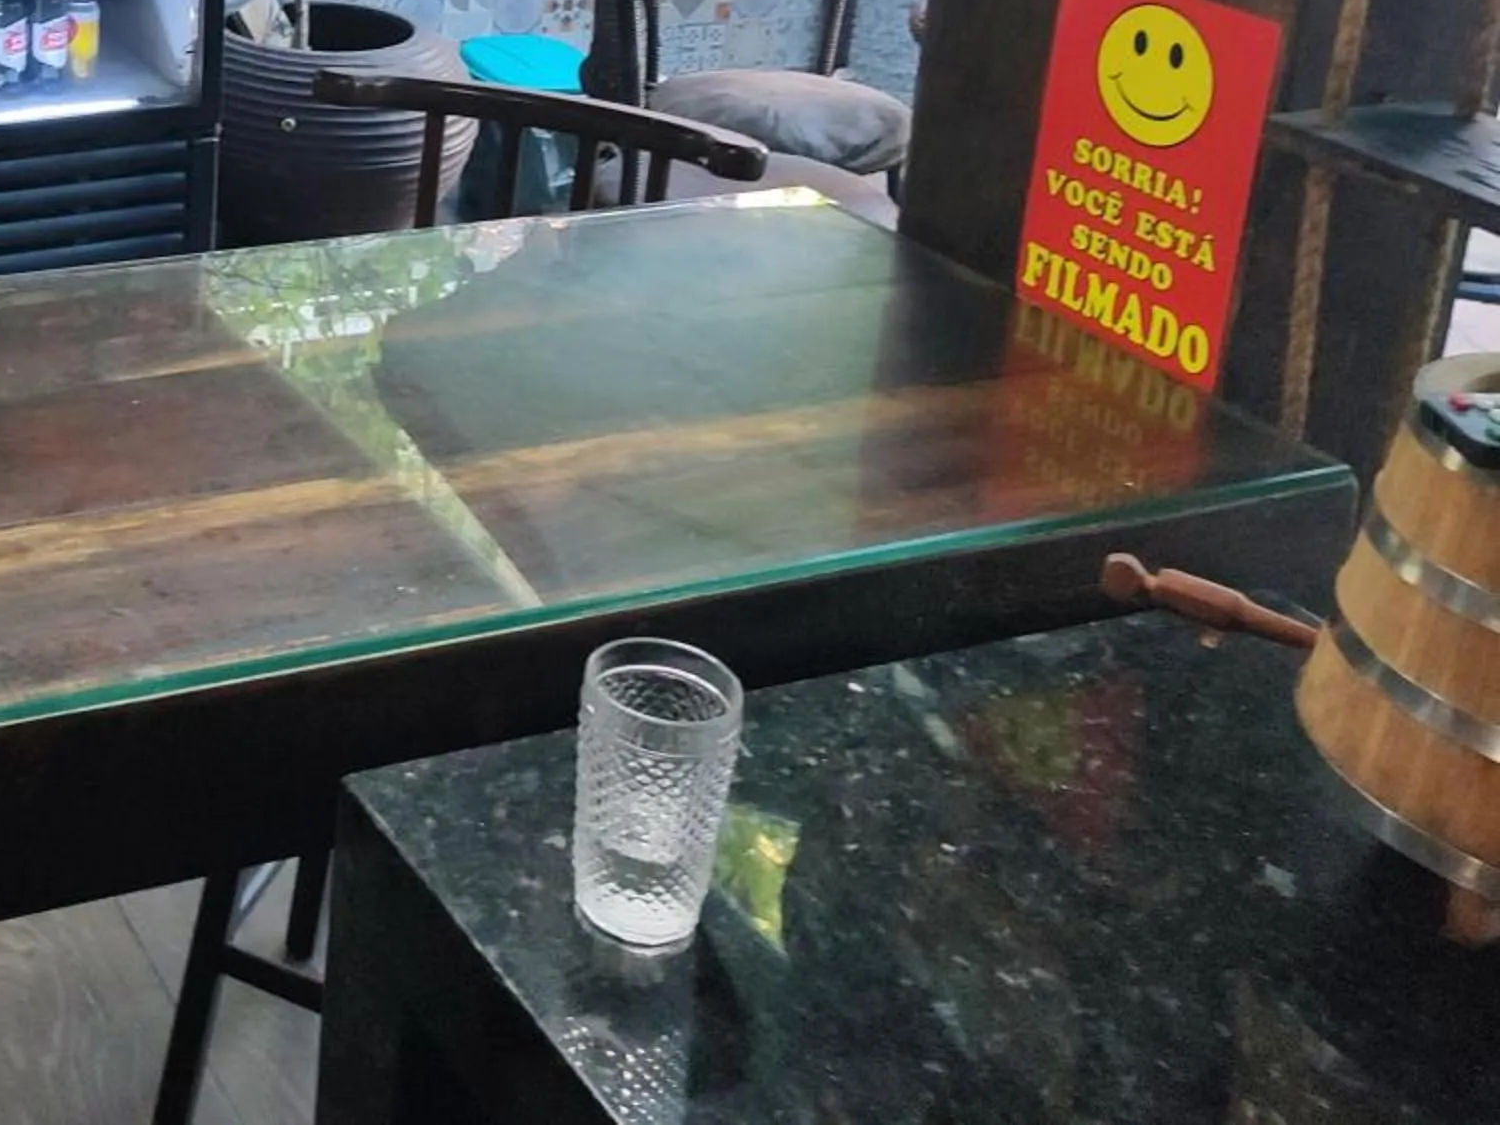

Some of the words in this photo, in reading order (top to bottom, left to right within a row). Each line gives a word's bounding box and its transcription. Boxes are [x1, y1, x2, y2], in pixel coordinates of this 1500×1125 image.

[1045, 169, 1124, 225] VOCÊ
[1134, 211, 1216, 272] ESTÁ
[1074, 138, 1203, 214] SORRIA!
[1071, 224, 1173, 291] SENDO
[1022, 241, 1209, 373] FILMADO
